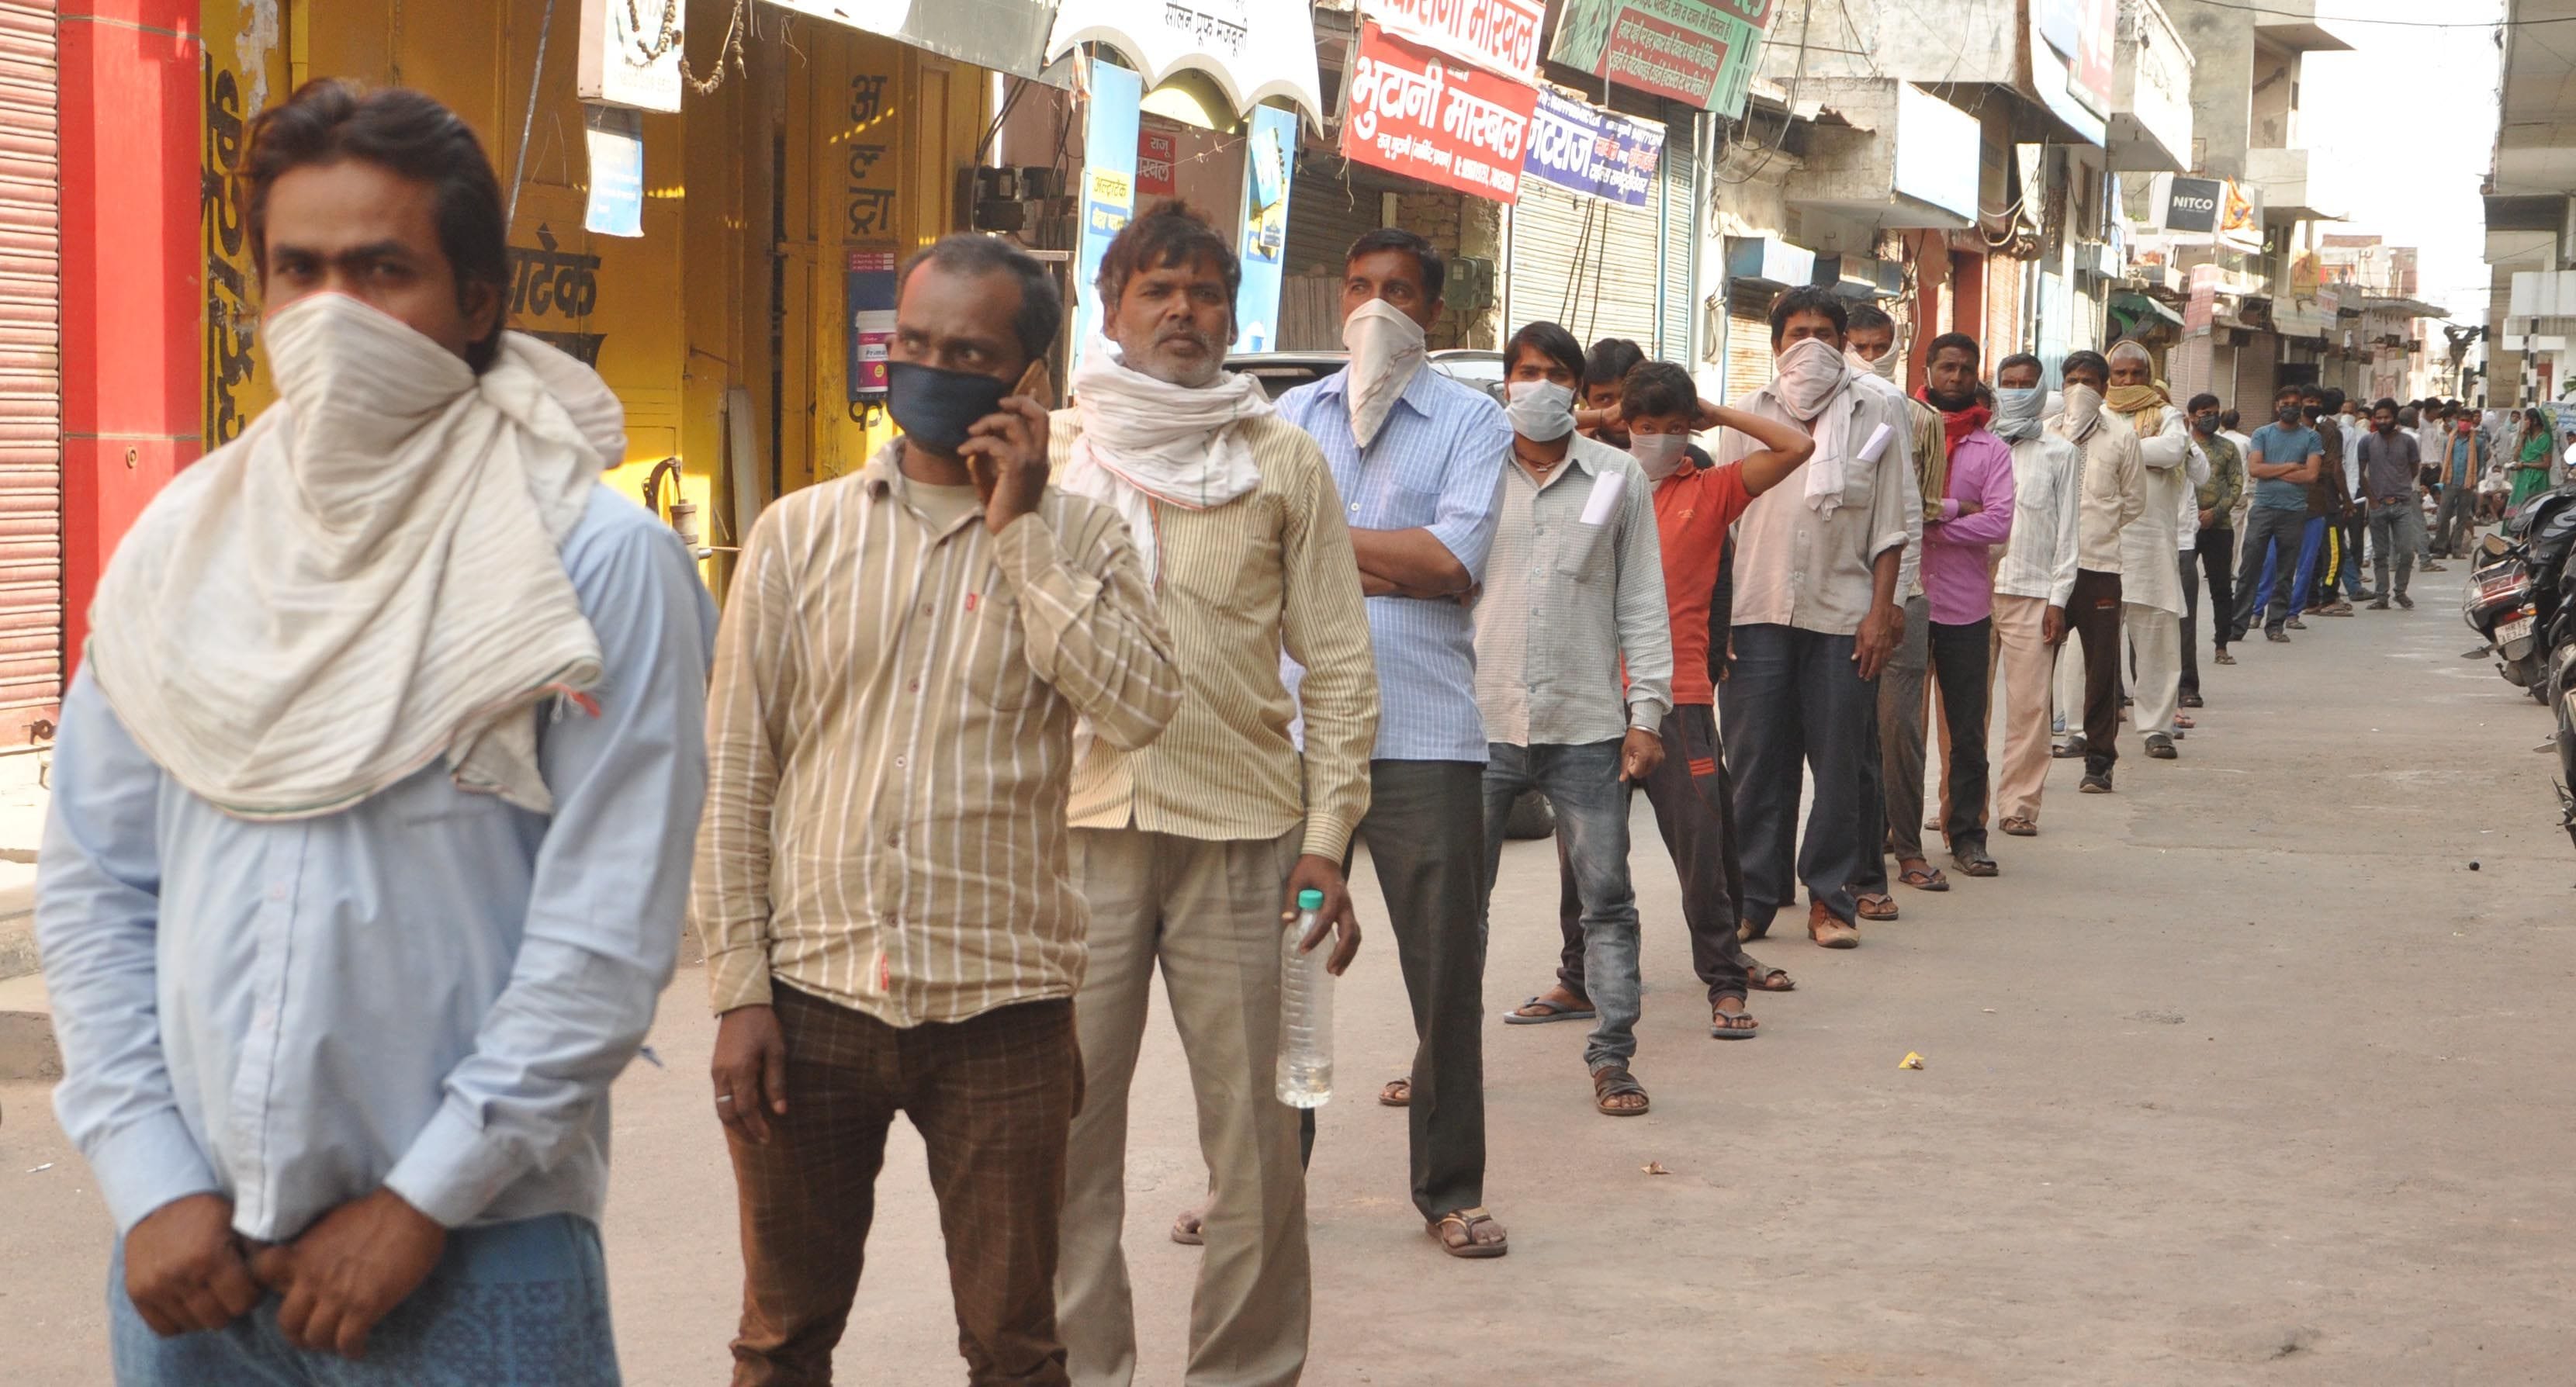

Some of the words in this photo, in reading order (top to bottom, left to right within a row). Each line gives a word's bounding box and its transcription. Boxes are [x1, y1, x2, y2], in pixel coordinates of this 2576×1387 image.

[1195, 12, 1214, 47] प्रूफ
[1216, 16, 1248, 57] मजबूती
[1352, 57, 1444, 140] भुटानी
[1443, 87, 1527, 160] मारबल
[1150, 137, 1170, 157] राजू
[1526, 106, 1598, 178] नटराज
[1137, 156, 1170, 182] ारबल
[1094, 176, 1127, 197] अल्ट्राटेक
[2173, 195, 2214, 210] NITCO
